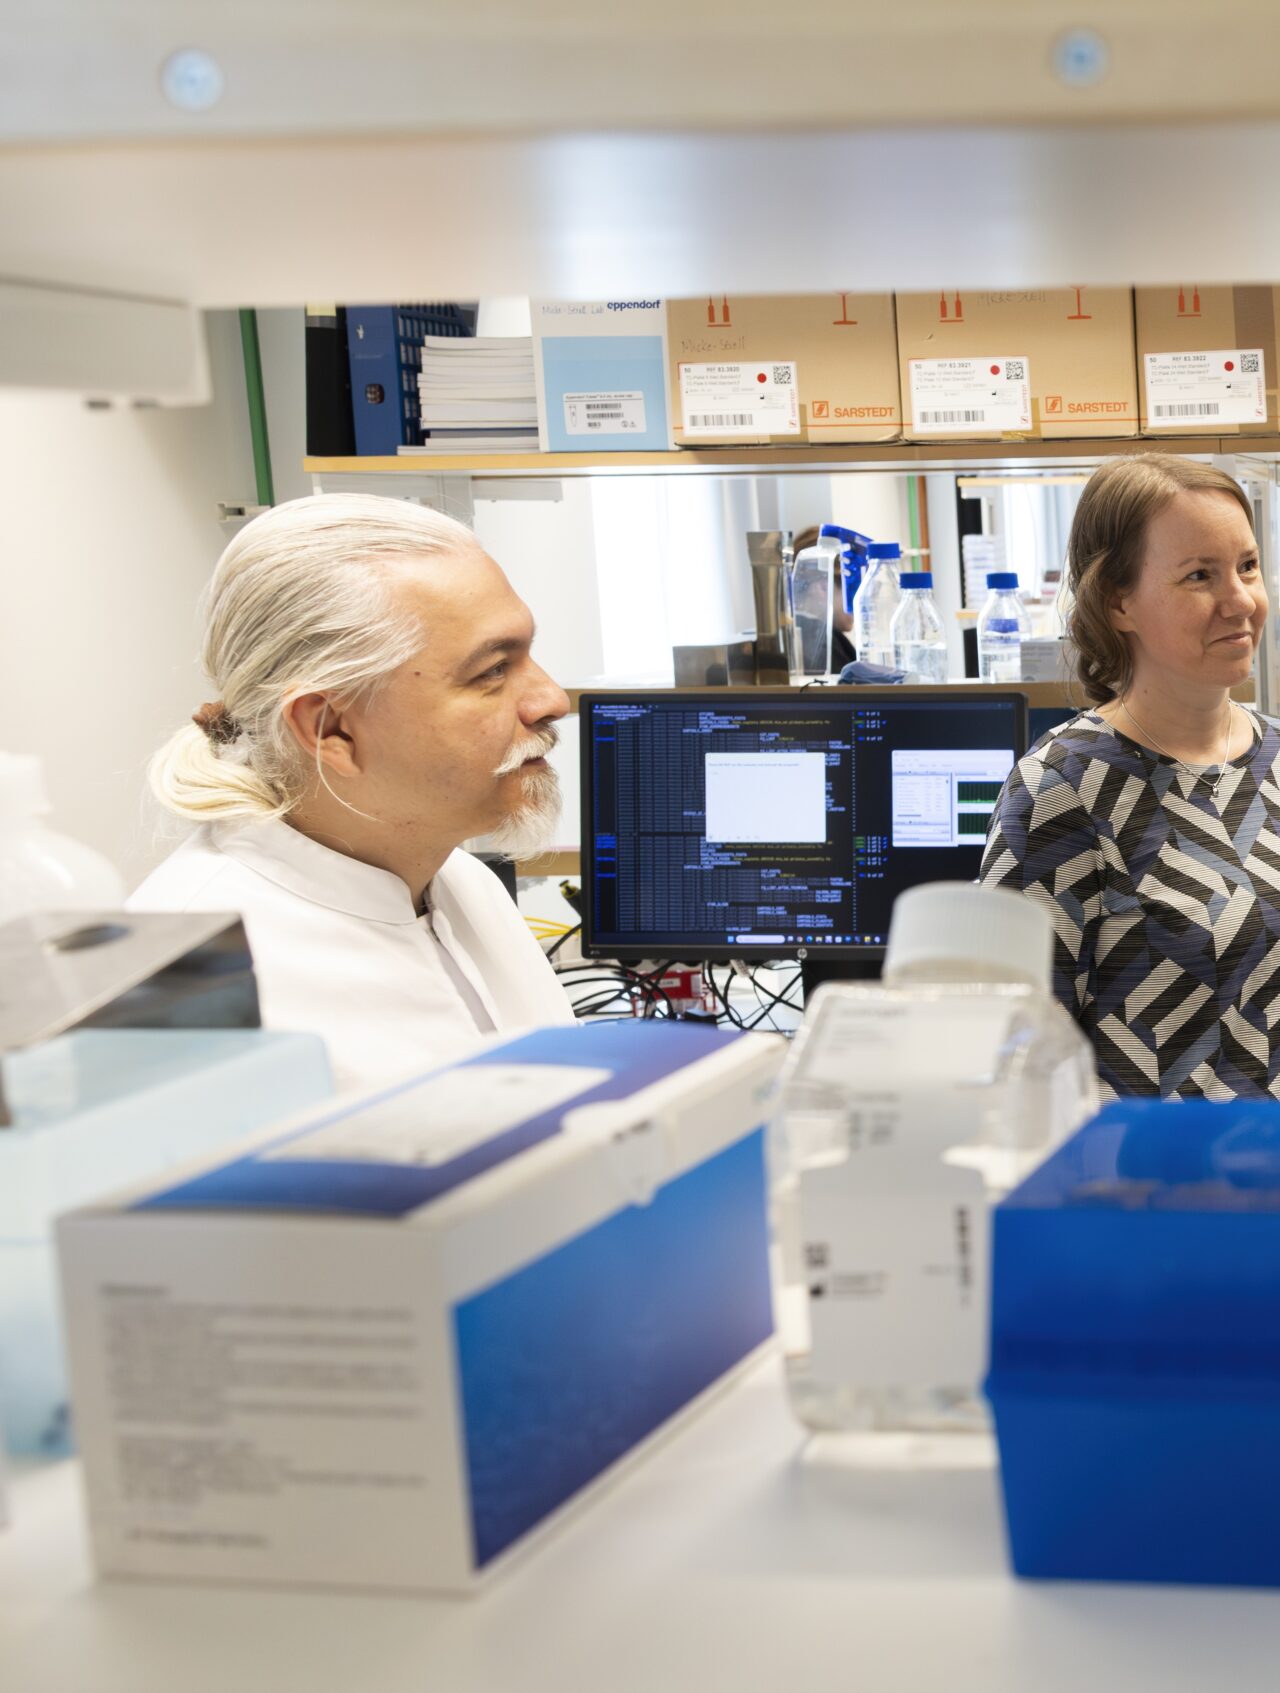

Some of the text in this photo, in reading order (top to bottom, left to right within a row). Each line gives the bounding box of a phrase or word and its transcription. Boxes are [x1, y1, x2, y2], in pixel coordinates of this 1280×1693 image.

[607, 299, 661, 311] eppendorf
[834, 407, 895, 418] SARSTEDT
[1068, 402, 1129, 413] SARSTEDT
